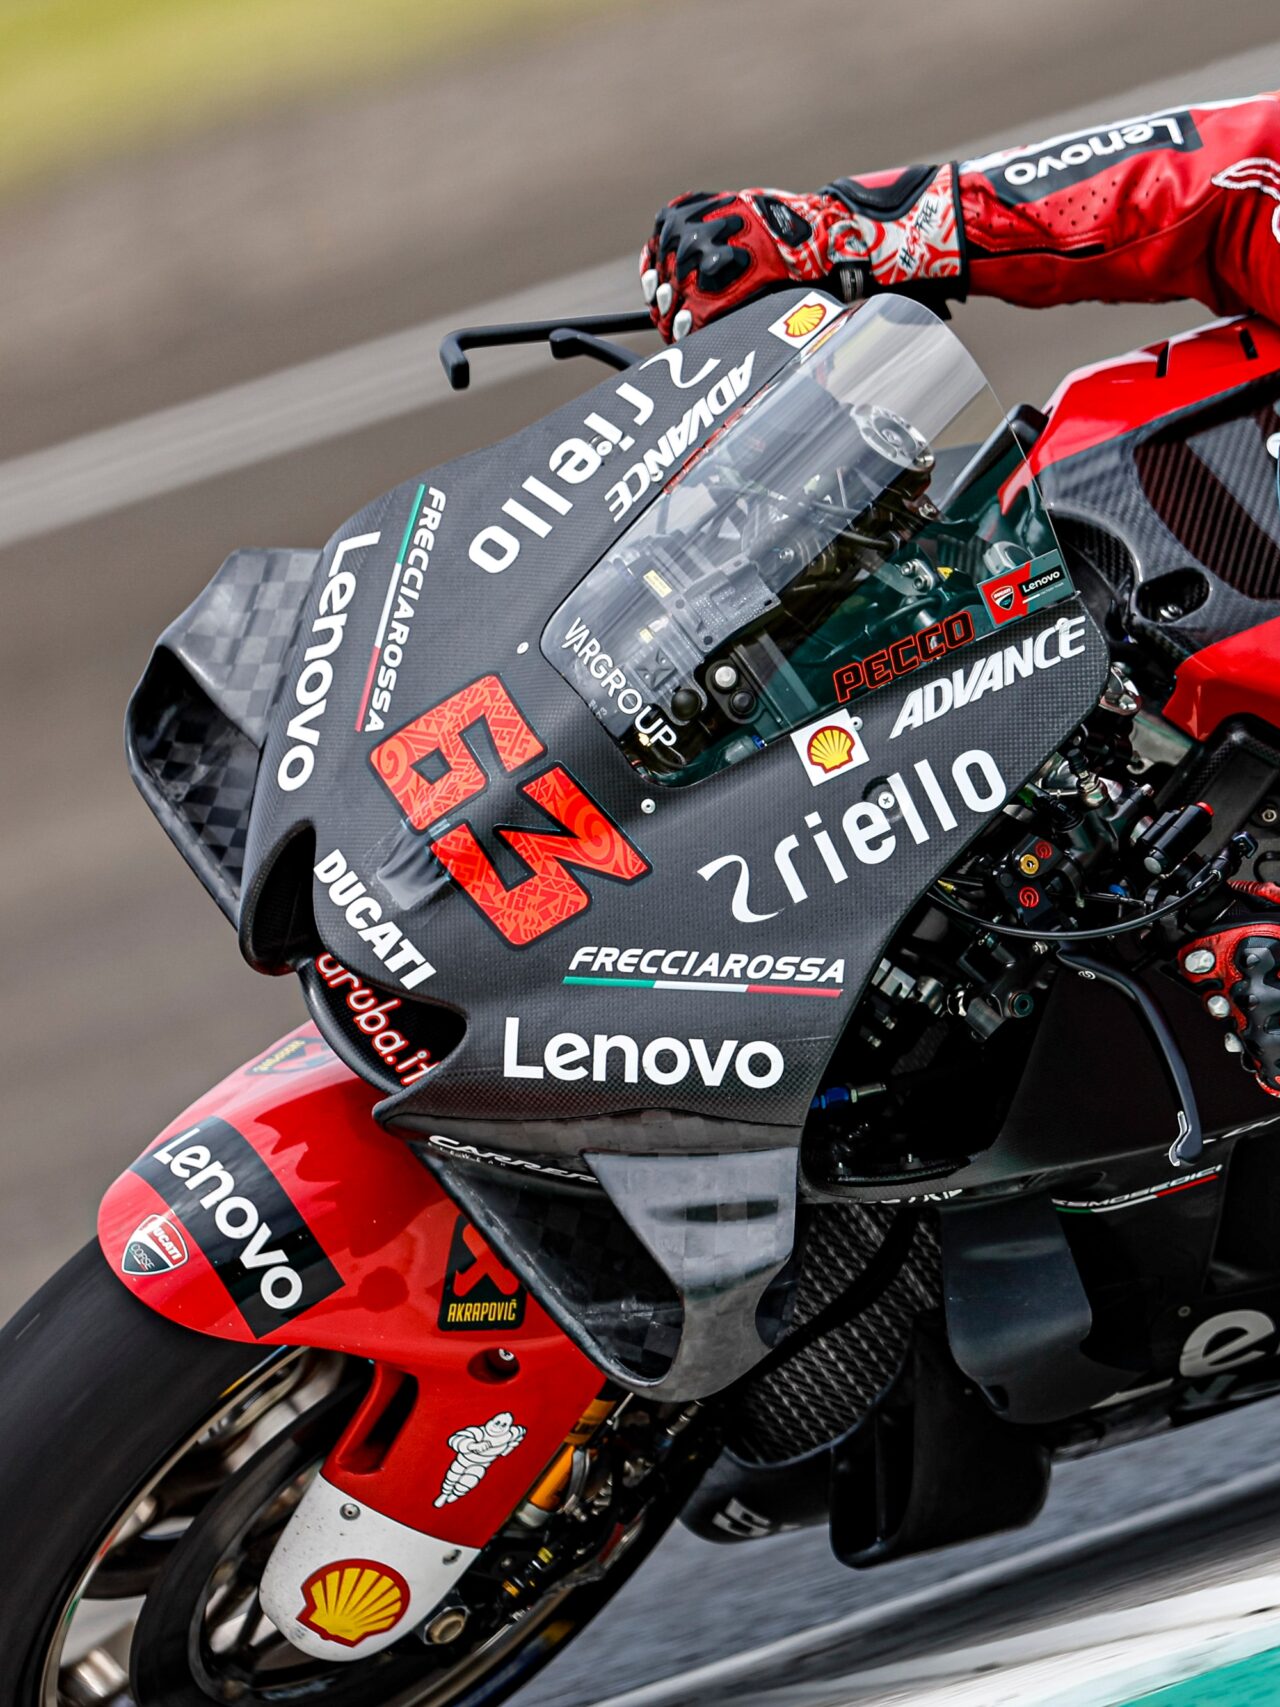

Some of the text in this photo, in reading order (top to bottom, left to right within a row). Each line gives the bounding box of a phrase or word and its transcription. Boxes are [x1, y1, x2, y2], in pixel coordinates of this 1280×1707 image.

[1003, 116, 1185, 187] Lenovo
[602, 350, 756, 523] ADVANCE
[363, 486, 447, 733] FRECCIAROSSA
[1021, 570, 1061, 594] Lenovo
[276, 531, 382, 792] Lenovo
[561, 616, 677, 747] VARGROUP
[832, 610, 975, 704] PECCO
[889, 615, 1087, 740] ADVANCE
[367, 672, 653, 949] 63
[313, 849, 437, 990] DUCATI
[568, 946, 846, 984] FRECCIAROSSA
[503, 1017, 785, 1090] Lenovo
[129, 1243, 156, 1272] CORSE
[151, 1127, 303, 1311] Lenovo
